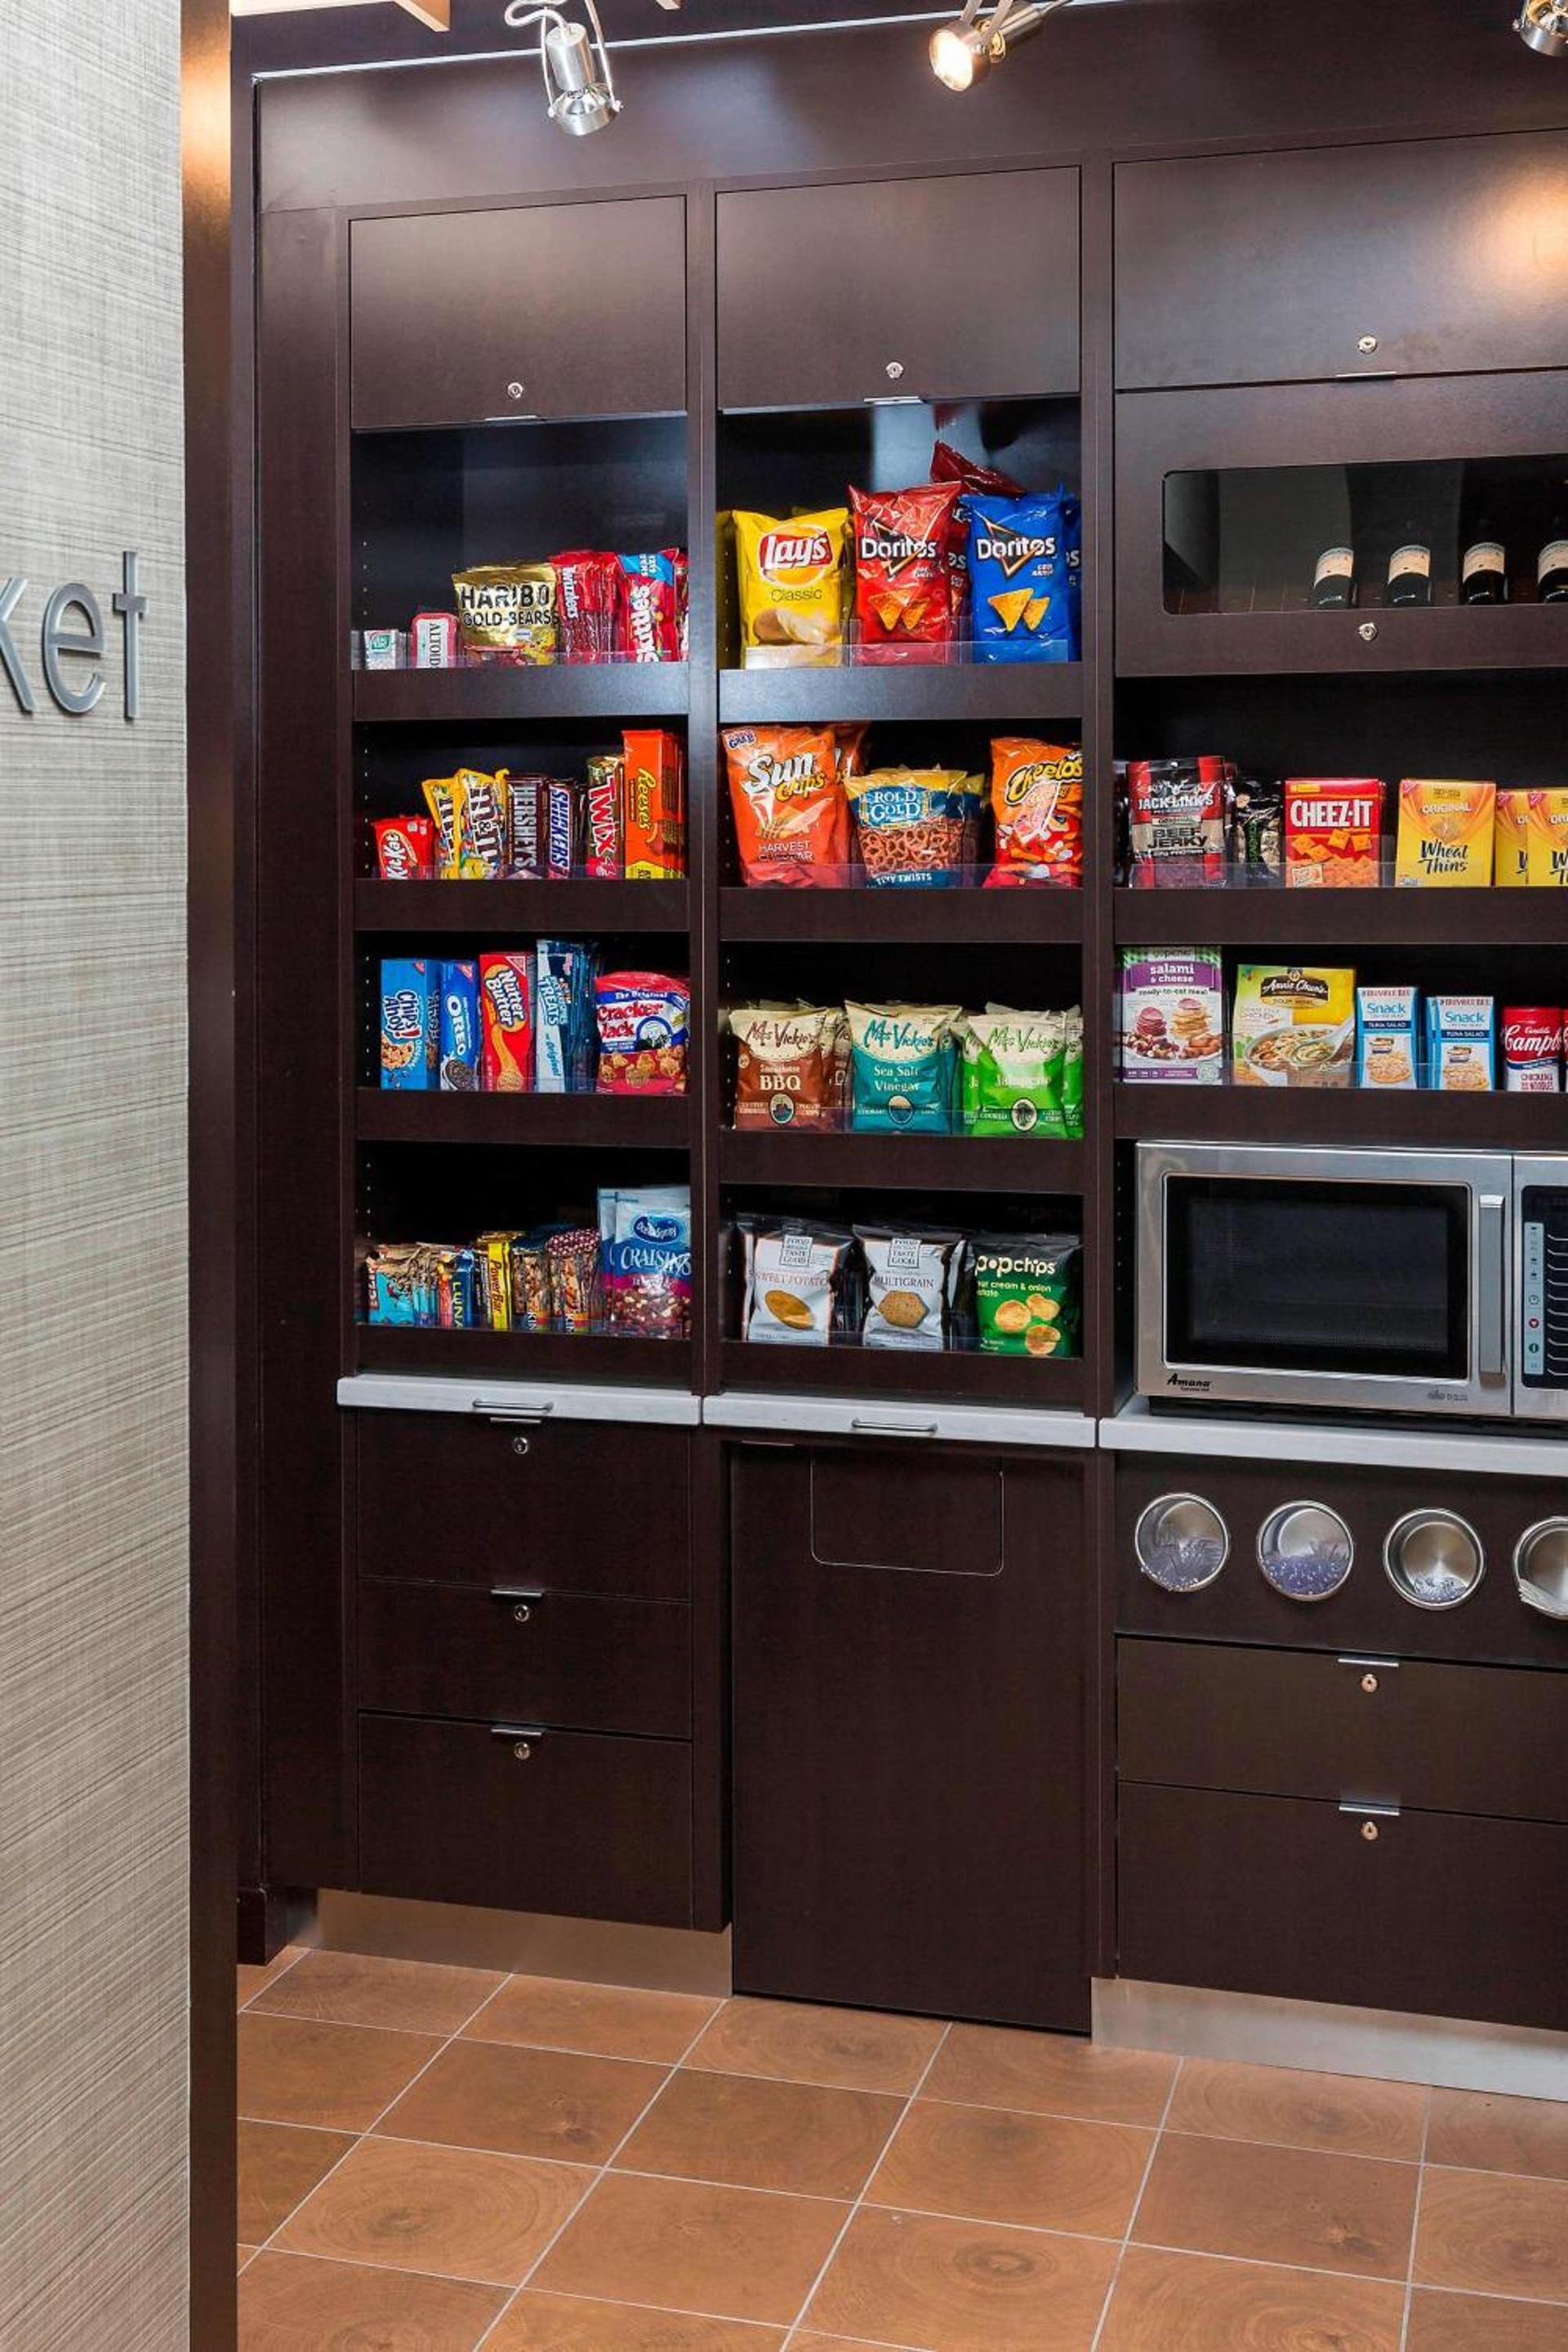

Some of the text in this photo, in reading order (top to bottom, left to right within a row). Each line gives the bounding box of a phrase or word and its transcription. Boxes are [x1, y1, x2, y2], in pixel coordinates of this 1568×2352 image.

[764, 534, 827, 570] Lay's
[861, 537, 937, 559] Doritos
[977, 537, 1055, 559] Doritos
[461, 583, 550, 609] HARIBO
[562, 564, 580, 619] Twizzlers
[771, 589, 823, 603] Classic
[630, 584, 660, 662] Skittles
[742, 752, 814, 793] Sun
[1006, 758, 1083, 803] Cheetos
[638, 768, 656, 831] Reese's
[874, 791, 917, 803] ROLD
[1138, 797, 1169, 810] JACK
[589, 775, 617, 857] TWIX
[871, 802, 921, 820] GOLD
[1290, 799, 1374, 828] CHEEZ-IT
[1422, 803, 1472, 814] ORIGINAL
[514, 785, 537, 868] HERSHEY'S
[550, 789, 568, 869] SNICKERS
[759, 840, 811, 852] HARVEST
[1147, 835, 1208, 849] JERKY
[1421, 839, 1468, 859] Wheat
[1418, 858, 1468, 875] Thins
[899, 872, 933, 882] TWISTS
[1150, 963, 1196, 974] salami
[1158, 974, 1194, 982] cheese
[485, 978, 514, 1027] Butter
[499, 969, 526, 1021] Nutter
[537, 980, 559, 1026] TREATS
[397, 991, 418, 1028] Chips
[597, 1003, 664, 1022] Cracker
[1366, 1002, 1405, 1014] Snack
[1445, 1011, 1486, 1023] Snack
[447, 995, 466, 1055] OREO
[600, 1021, 635, 1039] Jack
[874, 1065, 918, 1076] Sea Salt
[760, 1075, 801, 1091] BBQ
[874, 1080, 920, 1093] Vinegar
[974, 1255, 1056, 1278] popchips
[491, 1258, 505, 1315] PowerBar
[787, 1274, 828, 1286] POTATO
[873, 1276, 935, 1289] MULTIGRAIN
[990, 1281, 1018, 1290] cream
[1027, 1284, 1052, 1293] onion
[1166, 1373, 1211, 1388] Amana
